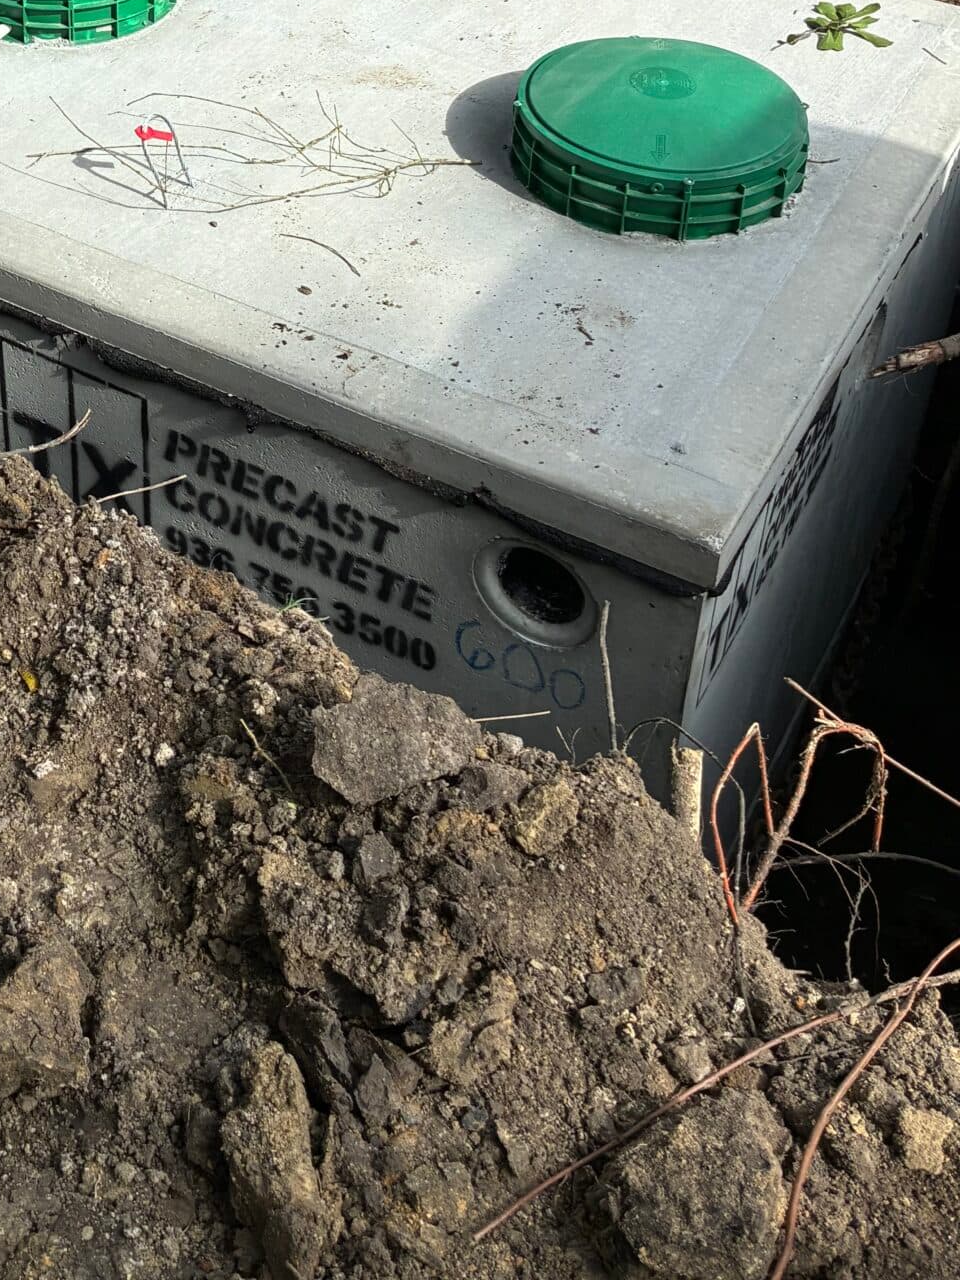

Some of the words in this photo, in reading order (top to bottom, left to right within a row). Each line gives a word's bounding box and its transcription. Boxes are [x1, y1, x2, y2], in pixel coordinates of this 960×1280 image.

[163, 429, 401, 554] PRECAST
[165, 477, 435, 621] CONCRETE
[454, 620, 586, 710] 600
